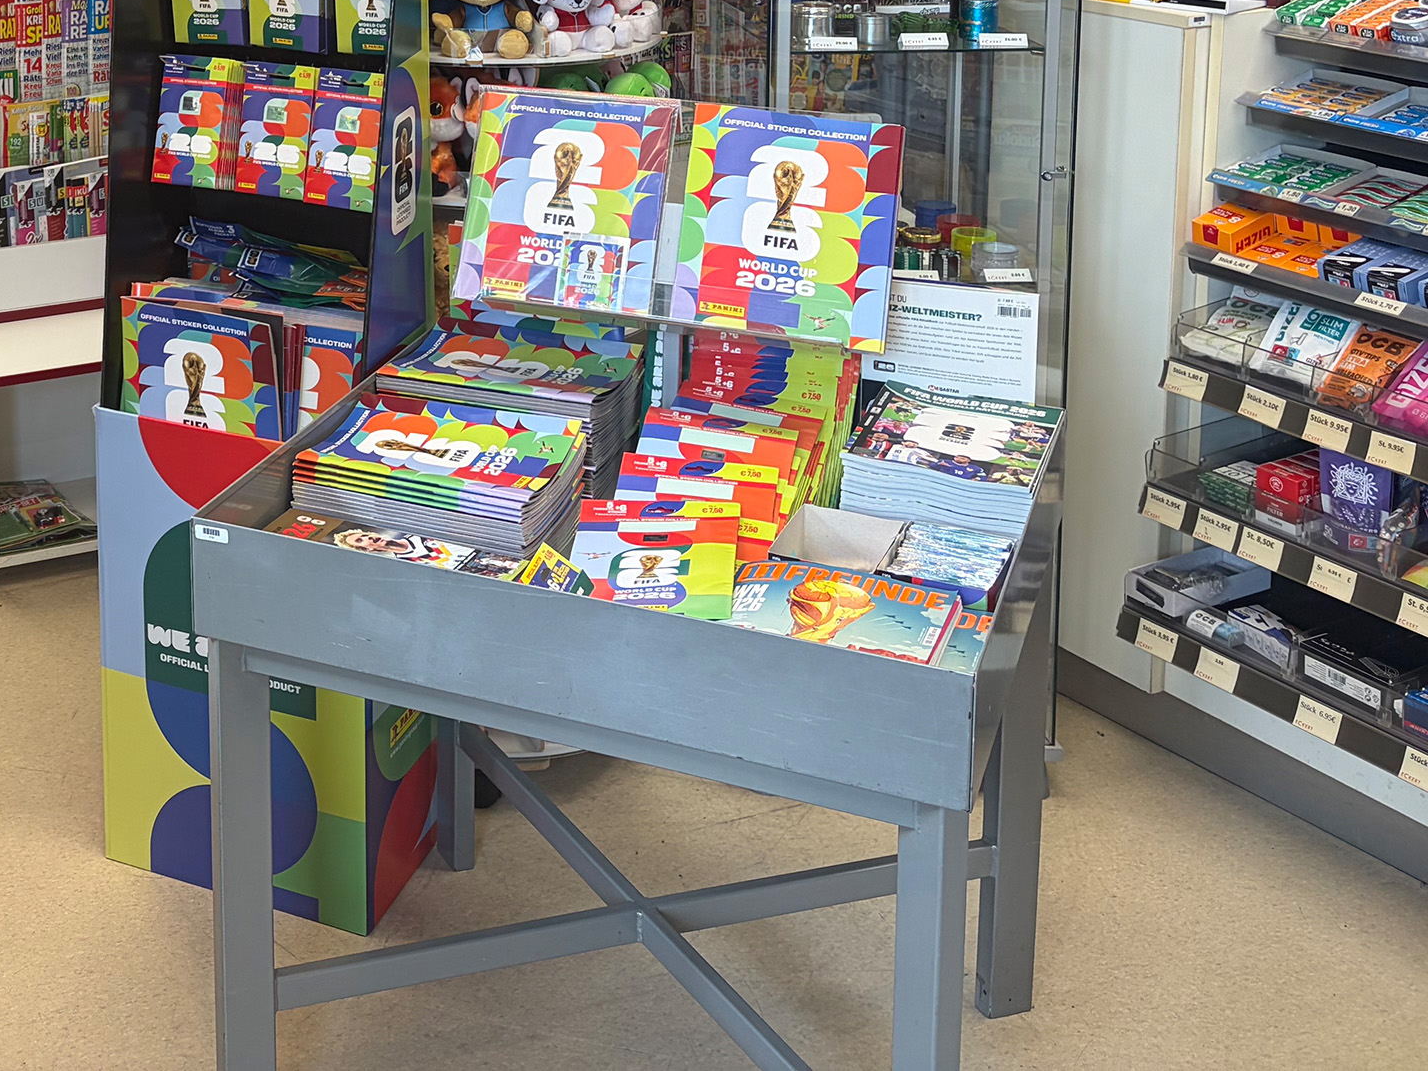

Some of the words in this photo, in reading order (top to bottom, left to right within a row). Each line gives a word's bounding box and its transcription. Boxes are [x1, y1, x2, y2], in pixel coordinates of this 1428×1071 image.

[511, 103, 548, 115] OFFICIAL
[550, 108, 585, 118] STICKER
[587, 111, 641, 123] COLLECTION
[724, 117, 765, 131] OFFICIAL
[767, 123, 806, 136] STICKER
[808, 128, 867, 142] COLLECTION
[543, 212, 576, 228] FIFA
[520, 235, 562, 249] WORLD
[763, 235, 798, 252] FIFA
[1218, 255, 1233, 265] Stück
[739, 258, 787, 276] WORLD
[790, 266, 818, 279] CUP
[494, 279, 525, 290] PANINI
[736, 272, 816, 297] 2026
[712, 303, 744, 315] PANINI
[889, 304, 982, 321] IZ-WELTMEISTER?
[140, 313, 170, 327] OFFICIAL
[172, 318, 201, 330] STICKER
[203, 322, 247, 337] COLLECTION
[904, 387, 930, 400] FIFA
[933, 391, 977, 406] WORLD
[981, 401, 1000, 410] CUP
[1003, 405, 1046, 418] 2026
[1247, 393, 1262, 404] Stück
[1310, 414, 1328, 426] Stück
[449, 448, 470, 463] FIFA
[484, 446, 519, 476] 2026
[702, 506, 724, 515] €7,50
[1246, 531, 1255, 540] St.
[613, 592, 675, 600] 2026
[734, 584, 765, 598] WM
[147, 623, 191, 652] WE
[160, 652, 203, 671] OFFICIAL
